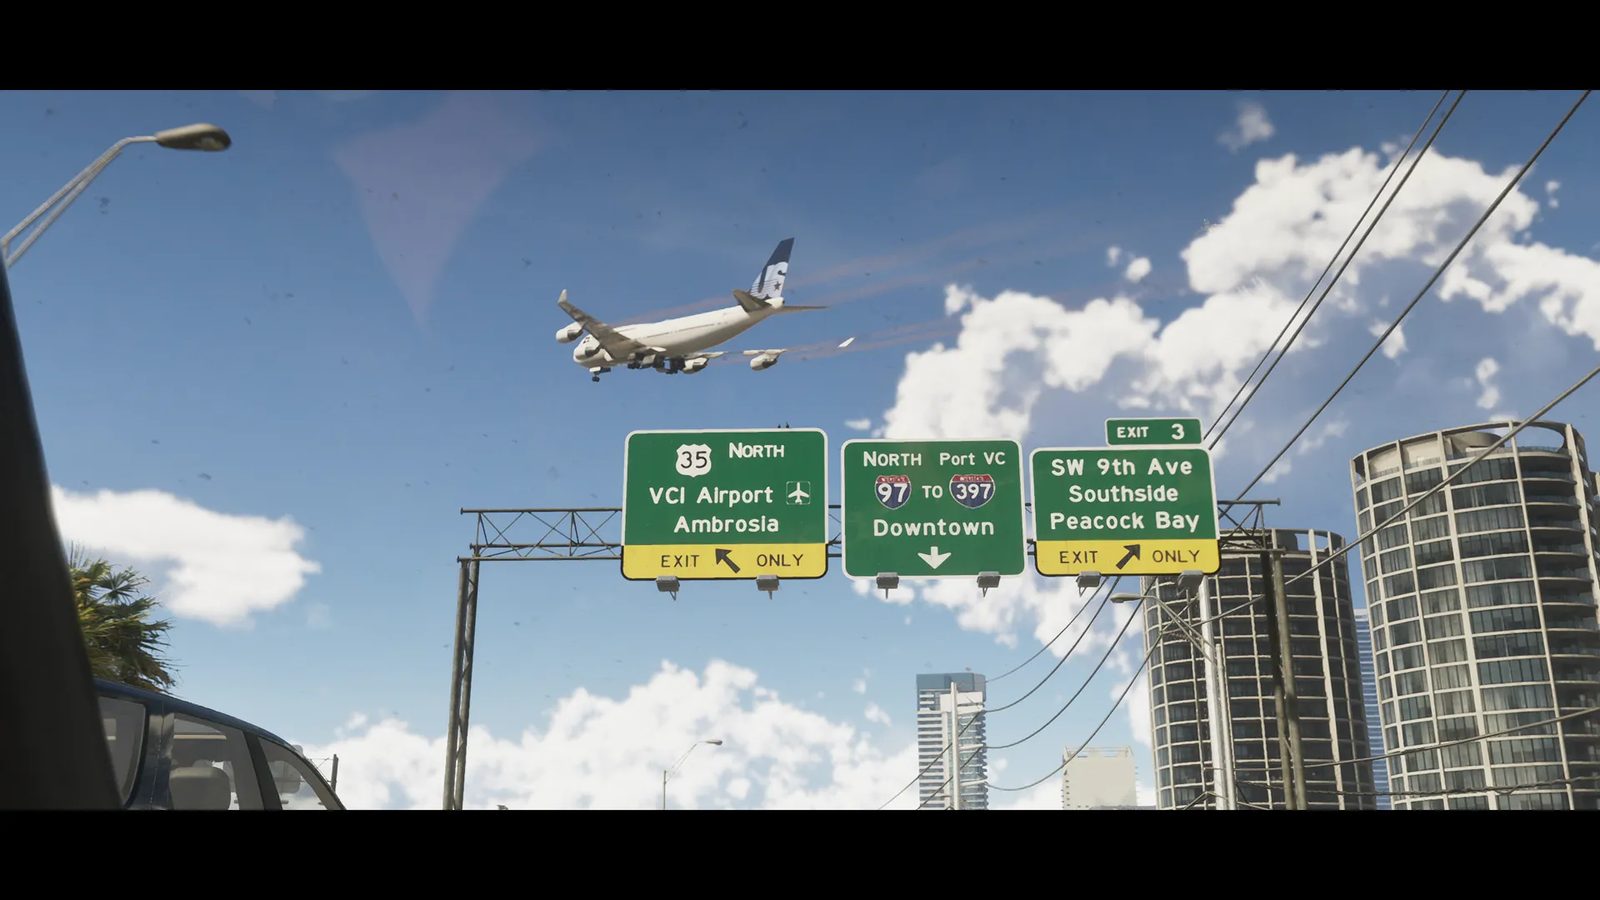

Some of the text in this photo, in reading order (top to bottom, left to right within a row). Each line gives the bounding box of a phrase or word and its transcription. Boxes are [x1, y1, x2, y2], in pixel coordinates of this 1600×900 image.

[1117, 424, 1185, 440] EXIT 3
[681, 442, 785, 468] 35 NORTH
[863, 451, 1006, 467] NORTH Port VC
[1051, 458, 1193, 476] SW 9th Ave
[649, 487, 774, 508] VCI Airport
[877, 483, 992, 503] 97 TO 397
[1068, 485, 1179, 502] Southside
[674, 515, 779, 533] Ambrosia
[873, 519, 994, 536] Downtown
[1051, 511, 1200, 533] Peacock Bay
[661, 554, 804, 567] EXIT ONLY
[1060, 550, 1200, 563] EXIT ONLY
